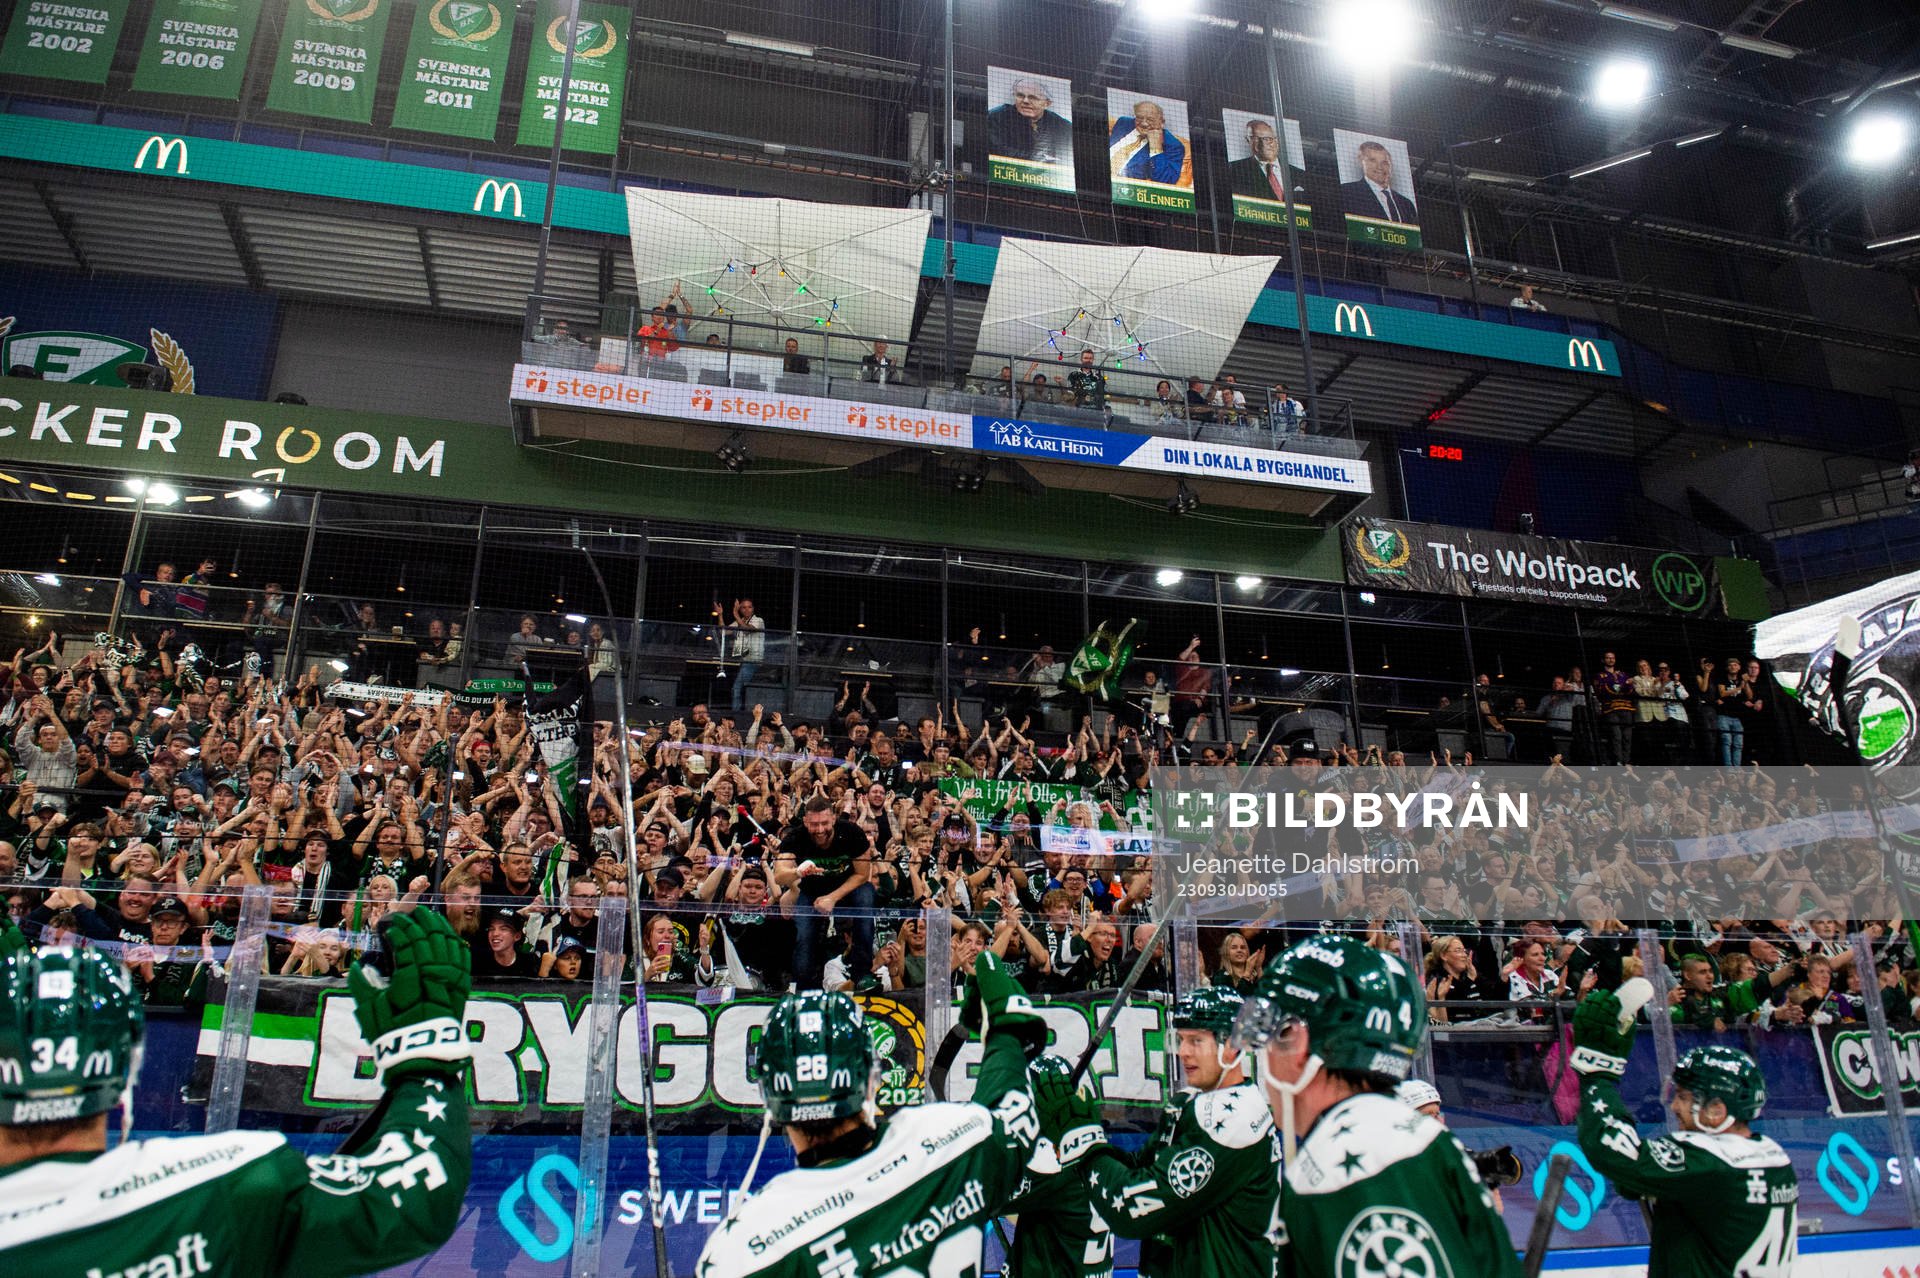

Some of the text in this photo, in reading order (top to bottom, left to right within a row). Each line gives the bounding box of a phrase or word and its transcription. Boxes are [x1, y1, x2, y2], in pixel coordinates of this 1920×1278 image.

[29, 1, 110, 22] SVENSKA
[26, 14, 107, 35] MÄSTARE
[162, 19, 240, 39] SVENSKA
[28, 31, 94, 54] 2002
[159, 32, 238, 52] MÄSTARE
[293, 39, 368, 60] SVENSKA
[160, 49, 225, 70] 2006
[290, 52, 366, 73] MÄSTARE
[417, 58, 492, 79] SVENSKA
[293, 69, 356, 92] 2009
[415, 71, 490, 92] MÄSTARE
[423, 88, 473, 110] 2011
[536, 88, 609, 107] MÄTARE
[1136, 191, 1191, 209] GLENNERT
[1237, 207, 1309, 228] EMANUELSON
[1381, 231, 1407, 245] LOOB
[556, 377, 651, 405] stepler
[721, 396, 812, 423] stepler
[876, 412, 962, 439] stepler
[218, 419, 446, 477] ROOM
[1001, 432, 1022, 448] AB
[1429, 445, 1463, 461] 20:20
[1164, 447, 1355, 484] DIN LOKALA BYGGHANDEL.
[1427, 541, 1641, 591] The Wolfpack
[1656, 569, 1701, 596] WP
[1549, 590, 1608, 603] supporterklubb
[472, 679, 553, 691] The Wopac
[1030, 783, 1058, 803] Olle
[1398, 1000, 1412, 1031] 4
[30, 1035, 80, 1074] 34
[796, 1054, 829, 1082] 26
[867, 1153, 909, 1183] CCM
[747, 1188, 855, 1256] Schaktmiljö
